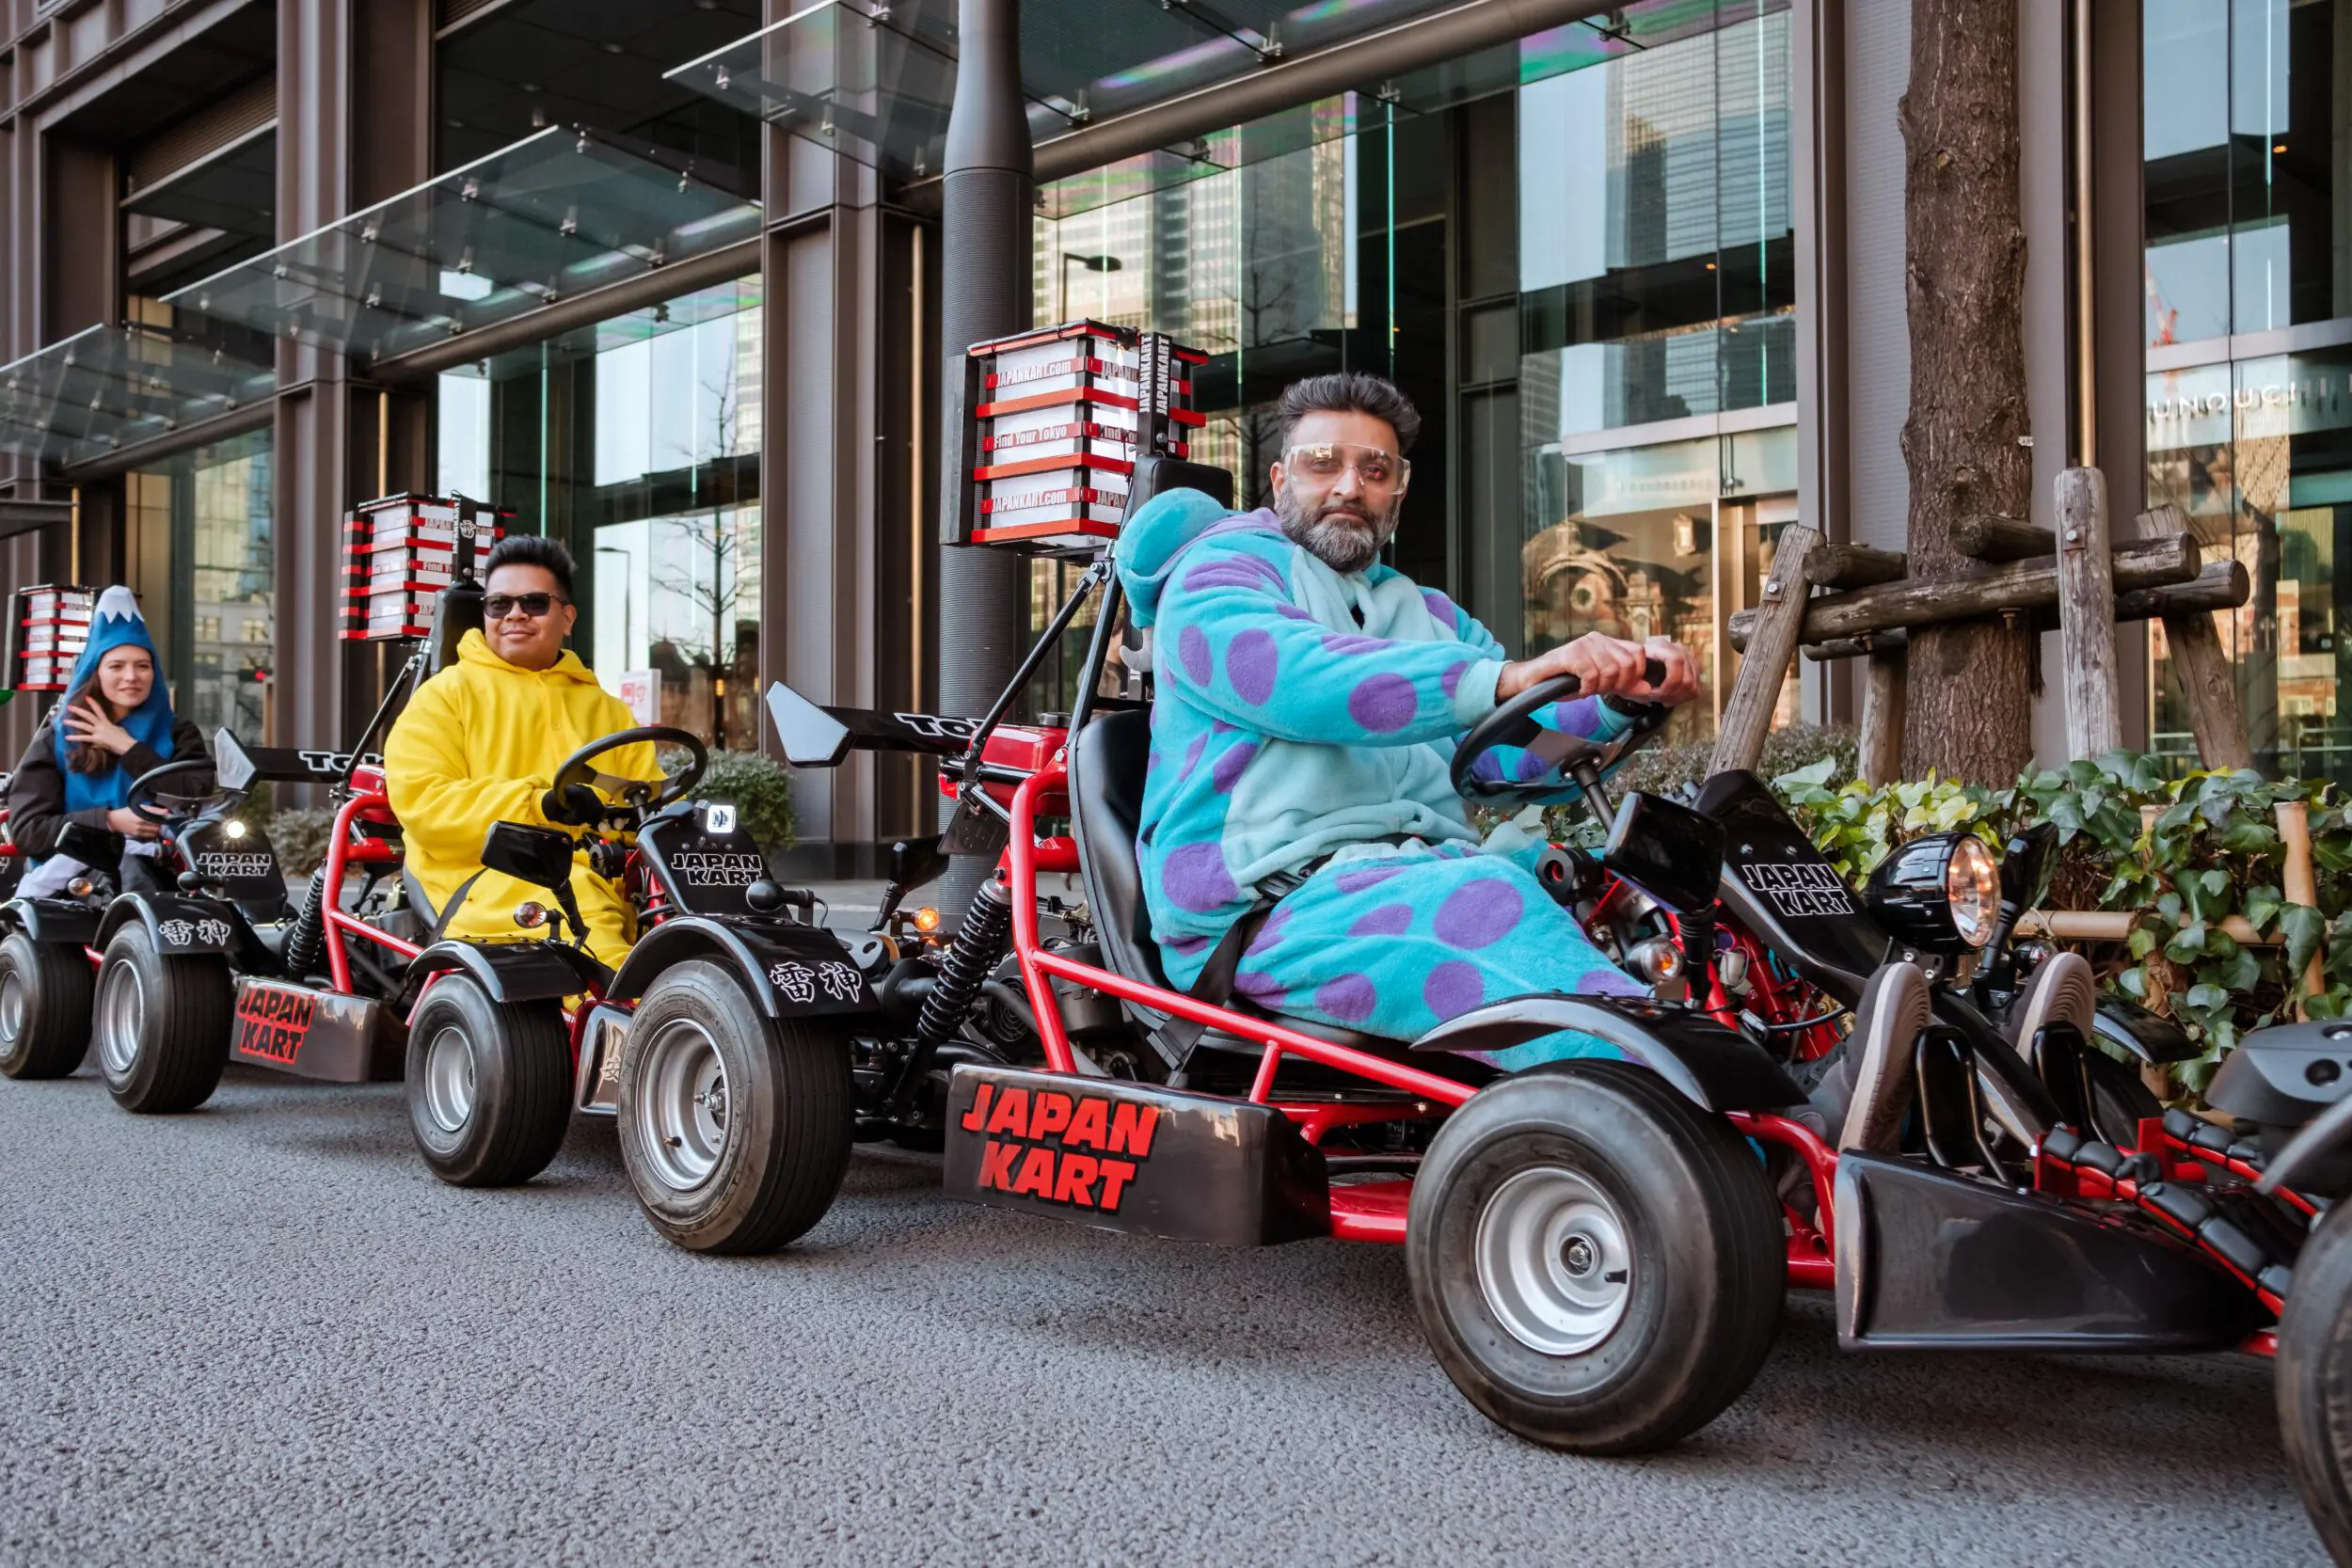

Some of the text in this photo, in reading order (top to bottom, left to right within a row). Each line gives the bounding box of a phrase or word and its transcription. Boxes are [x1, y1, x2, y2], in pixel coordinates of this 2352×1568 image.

[995, 360, 1072, 388] JAPANKART.com
[1138, 336, 1152, 414] JAPANKART
[1155, 335, 1170, 416] JAPANKART
[993, 424, 1068, 450] Find Your Tokyo
[993, 490, 1067, 513] JAPANKART.com
[197, 852, 272, 866] JAPAN
[208, 864, 270, 877] KART
[670, 852, 763, 870] JAPAN
[687, 868, 763, 886] KART
[1741, 863, 1844, 892] JAPAN
[1768, 889, 1855, 917] KART
[158, 918, 231, 947] 雷神
[769, 960, 863, 1004] 雷神
[236, 987, 317, 1033] JAPAN
[240, 1021, 306, 1065] KART
[961, 1083, 1161, 1158] JAPAN
[977, 1139, 1137, 1211] KART
